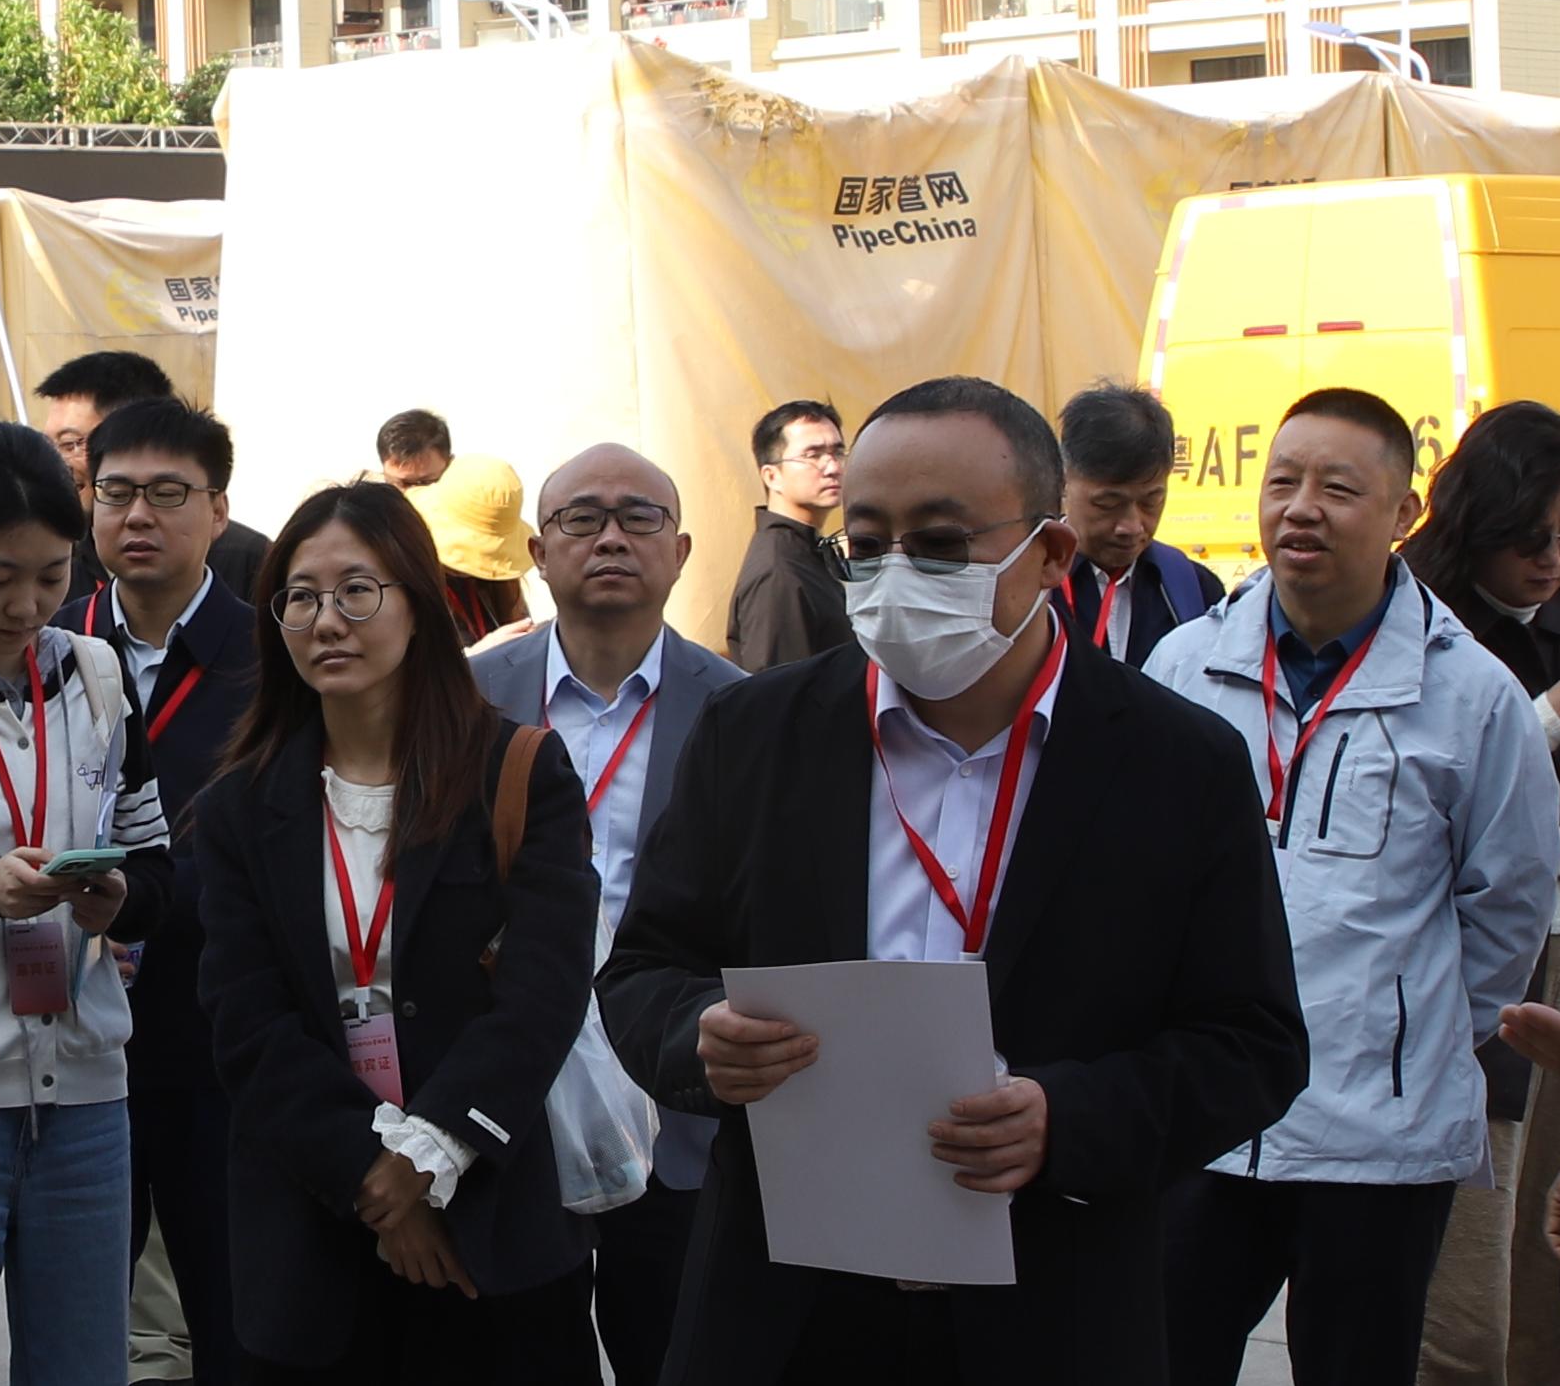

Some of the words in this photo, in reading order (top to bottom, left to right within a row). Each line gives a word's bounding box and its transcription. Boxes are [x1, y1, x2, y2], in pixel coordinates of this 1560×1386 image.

[834, 171, 969, 215] 国家管网
[832, 217, 977, 253] PipeChina
[165, 277, 220, 301] 国家
